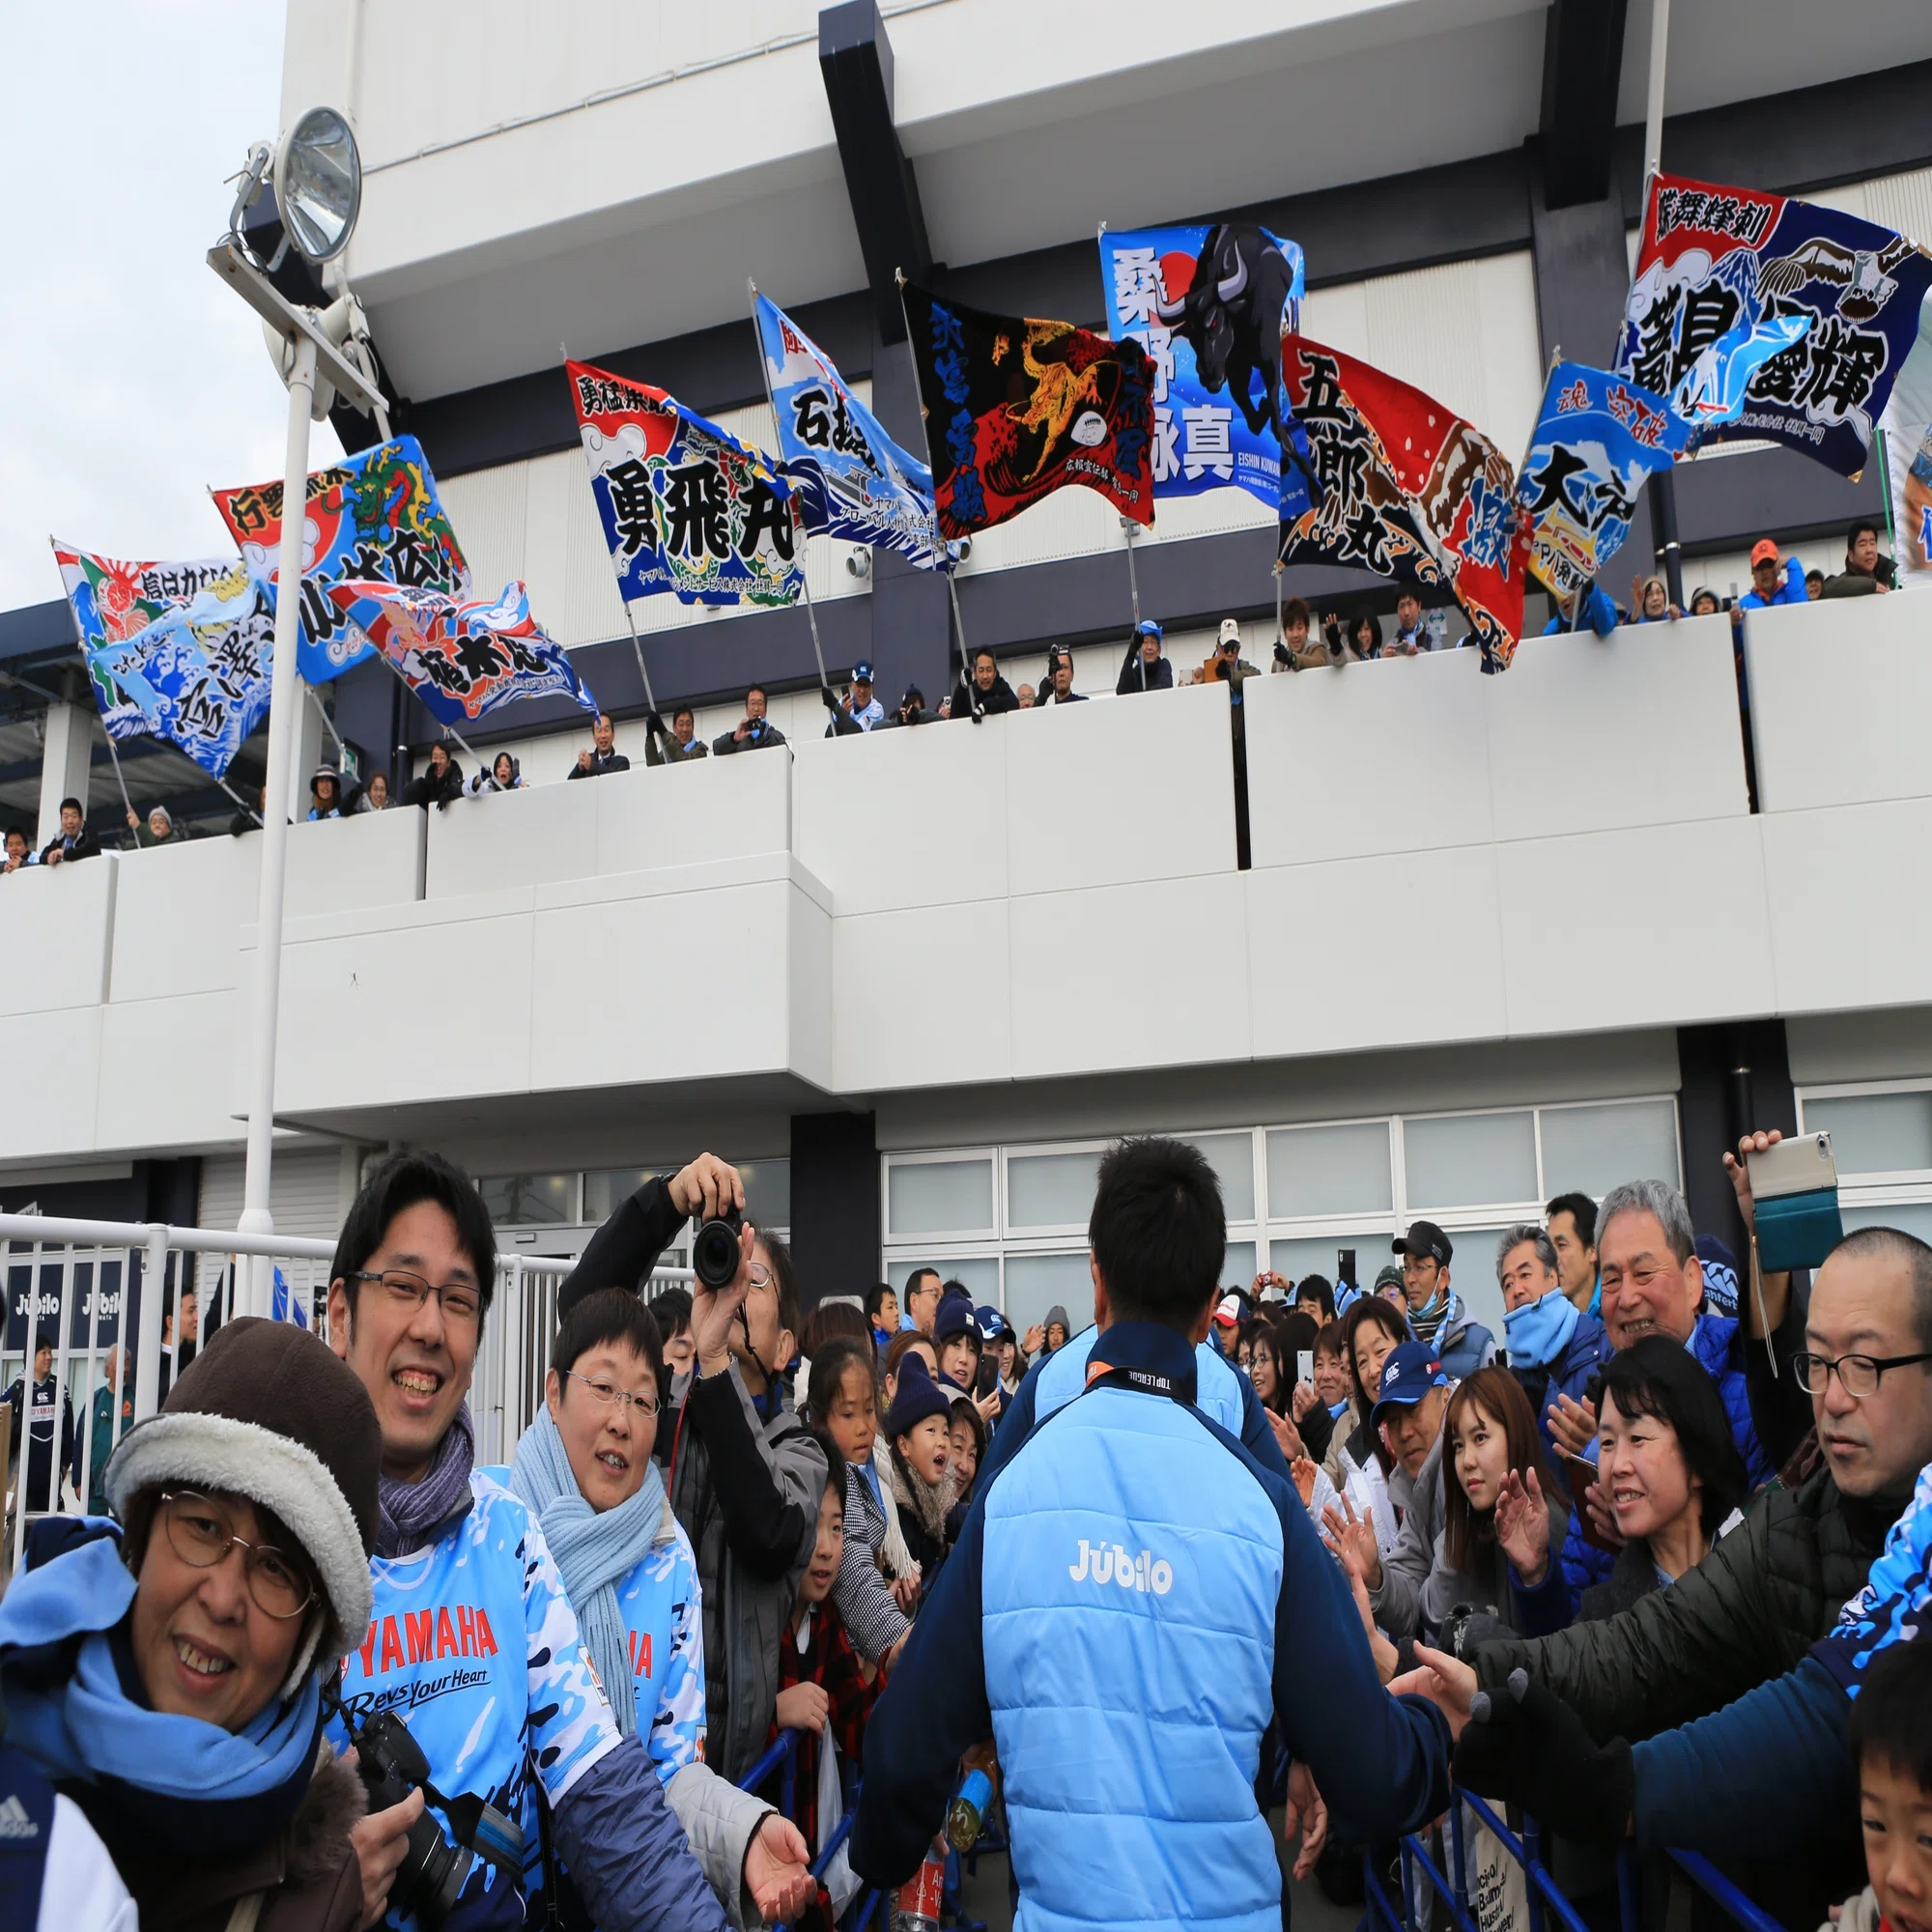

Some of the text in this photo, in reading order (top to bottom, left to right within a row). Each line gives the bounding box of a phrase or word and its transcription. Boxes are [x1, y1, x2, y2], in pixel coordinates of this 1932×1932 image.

[1238, 452, 1260, 469] EISHIN
[1292, 349, 1394, 576] 五郎丸
[357, 1605, 499, 1679] YAMAHA
[409, 1673, 452, 1710] Your
[451, 1668, 489, 1689] Heart
